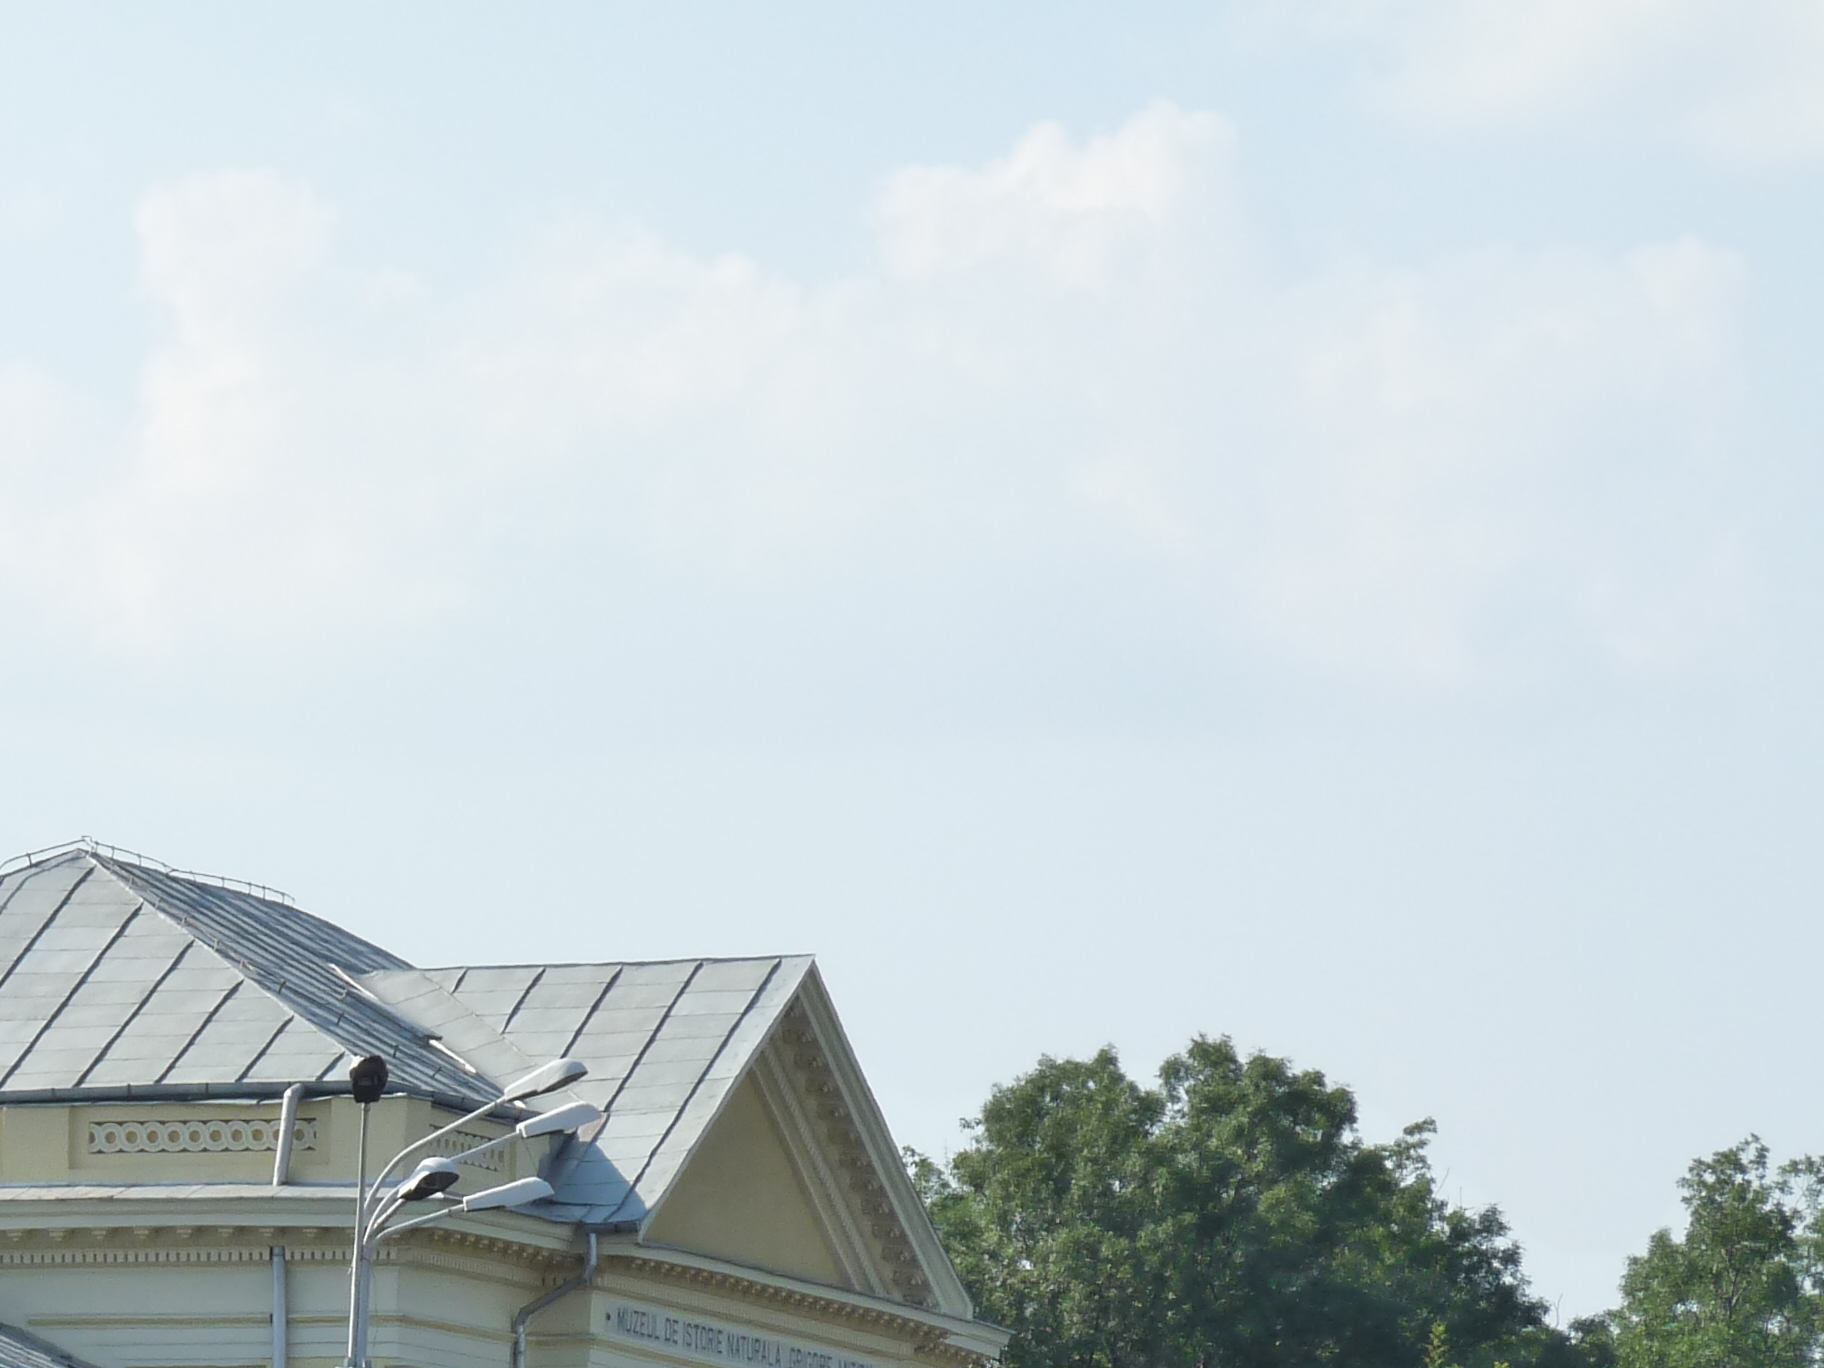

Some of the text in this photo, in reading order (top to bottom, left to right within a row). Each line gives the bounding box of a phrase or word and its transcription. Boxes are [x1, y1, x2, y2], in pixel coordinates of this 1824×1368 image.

[616, 1307, 660, 1340] MUZEUL
[663, 1316, 679, 1345] DE
[682, 1322, 723, 1354] ISTORIE
